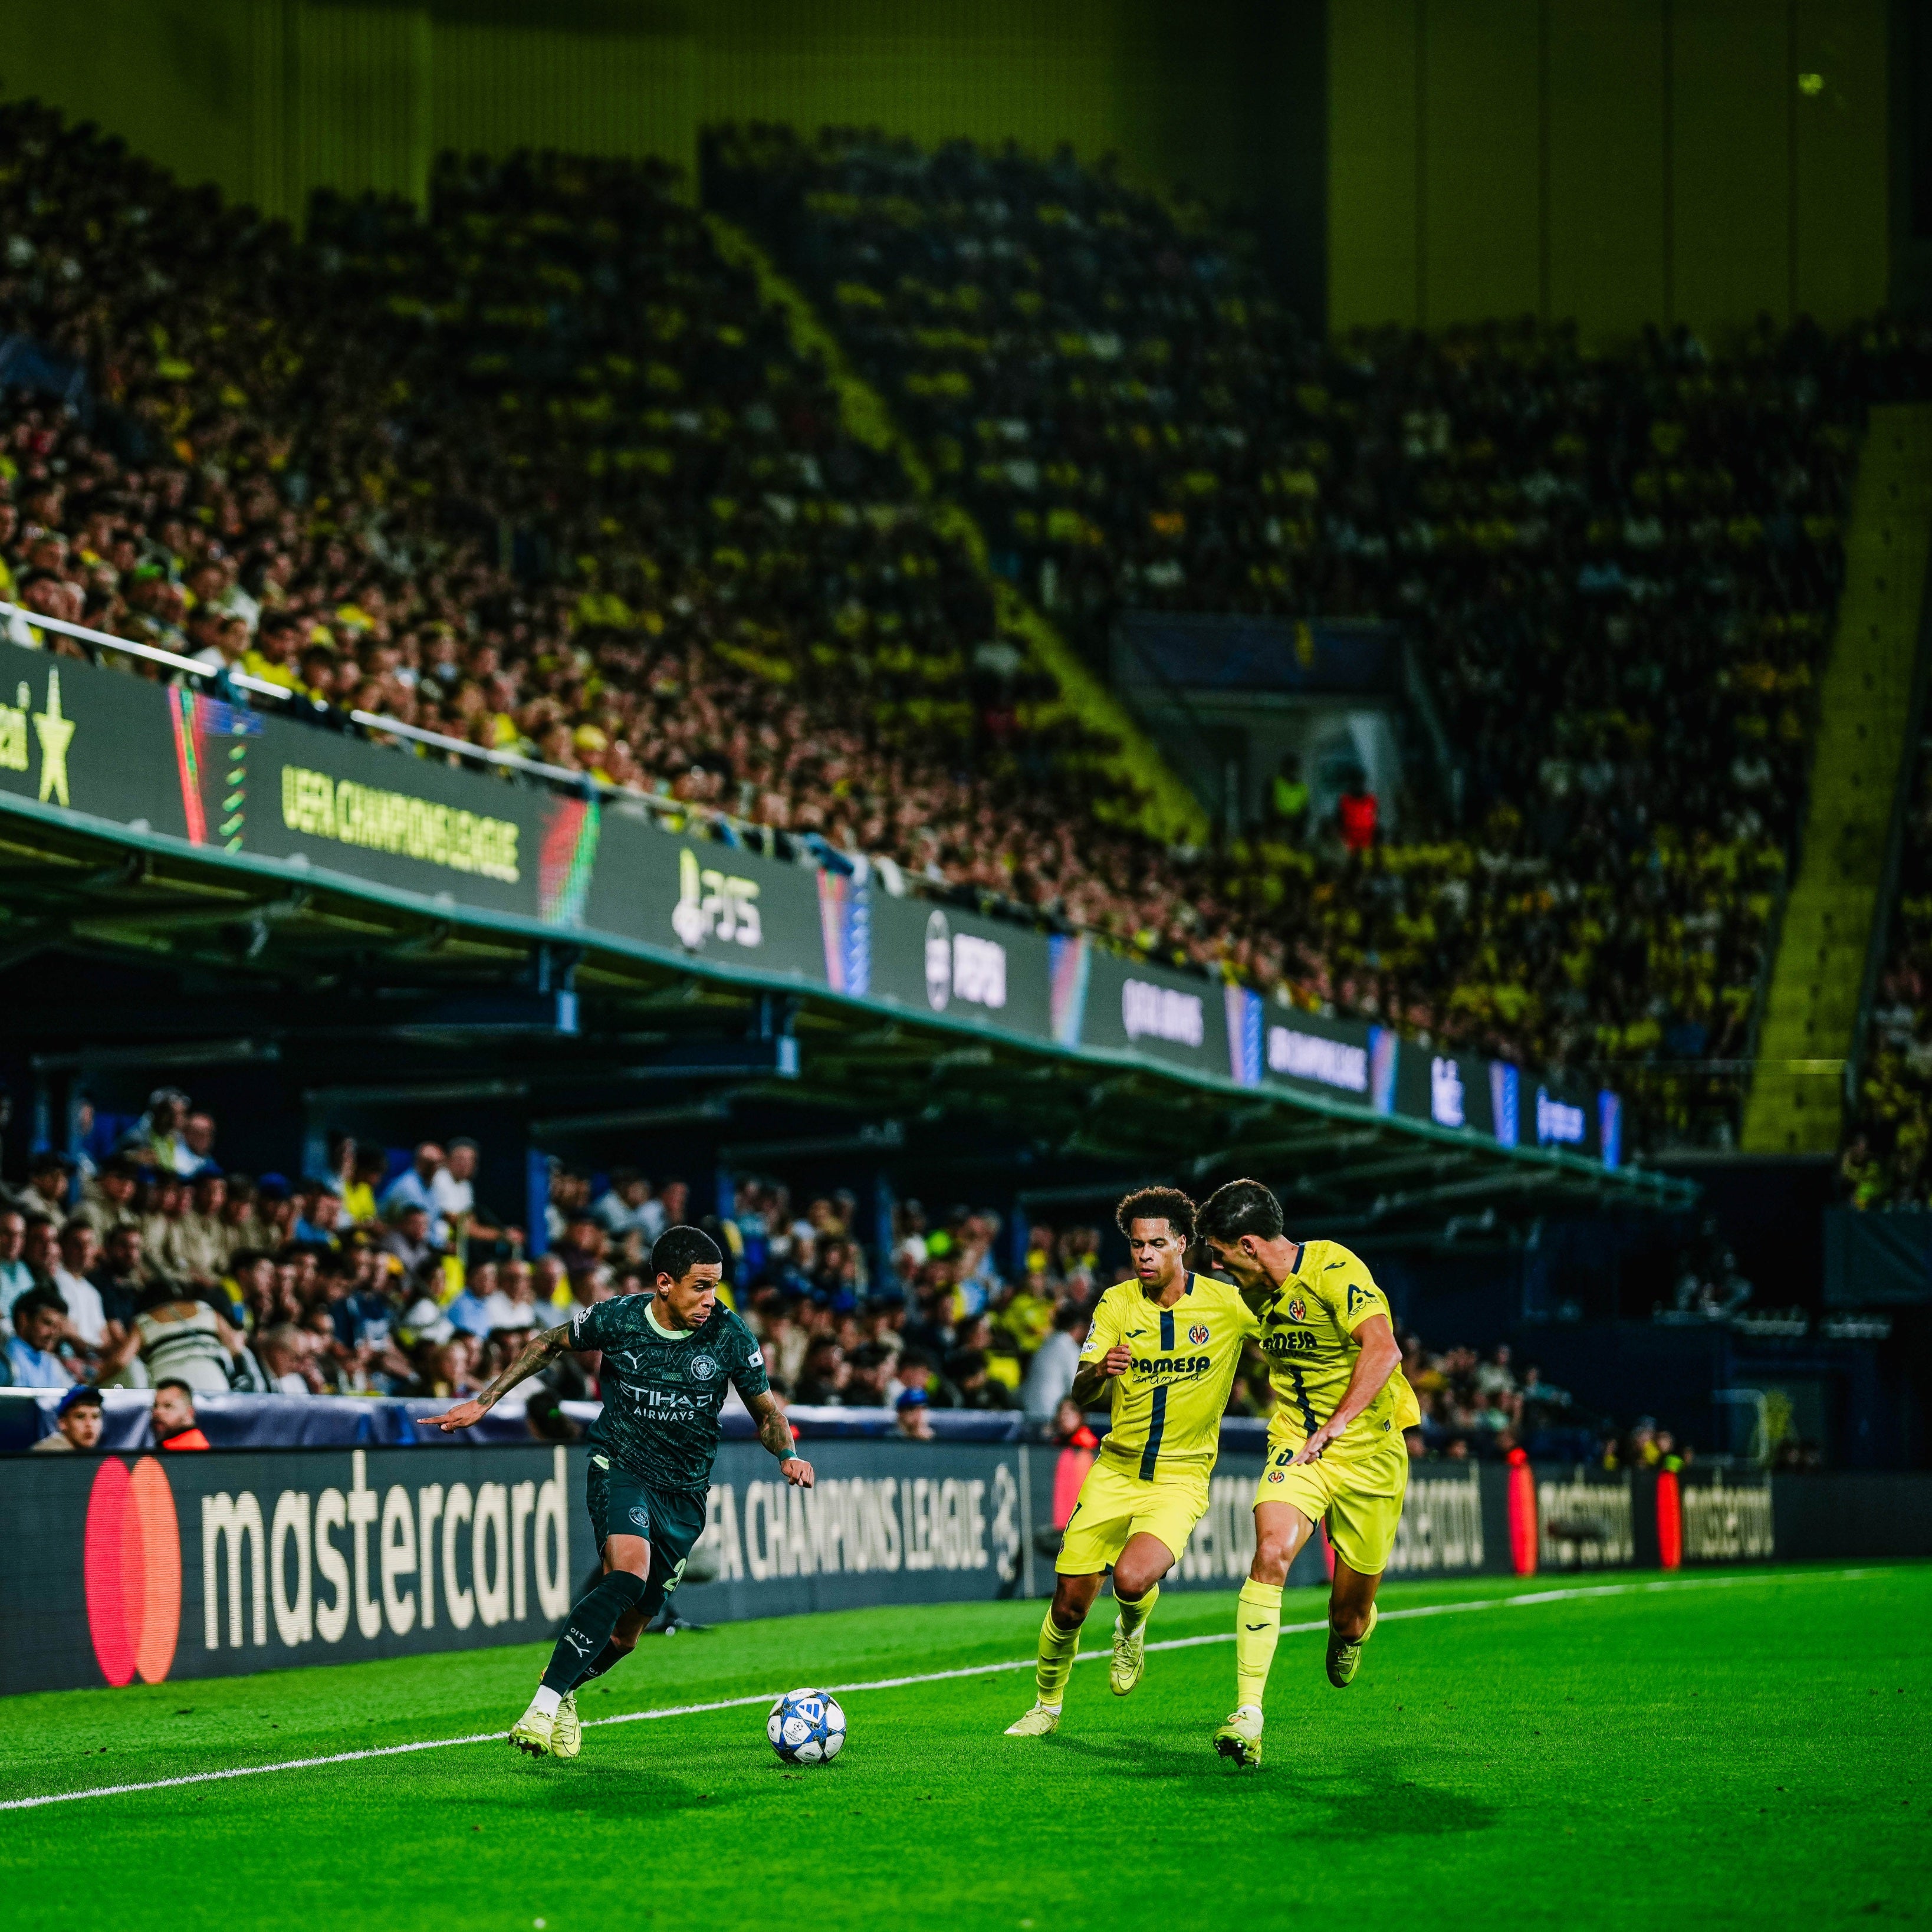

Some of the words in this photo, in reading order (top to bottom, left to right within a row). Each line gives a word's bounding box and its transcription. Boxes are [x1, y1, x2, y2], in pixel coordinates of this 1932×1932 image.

[1262, 1330, 1317, 1350] AMESA
[1131, 1356, 1210, 1374] PAMESA
[619, 1379, 712, 1408] ETIHAD
[633, 1405, 695, 1421] AIRWAYS
[744, 1477, 902, 1583] CHAMPIONS
[901, 1477, 988, 1571] LEAGUE
[202, 1445, 570, 1650] mastercard
